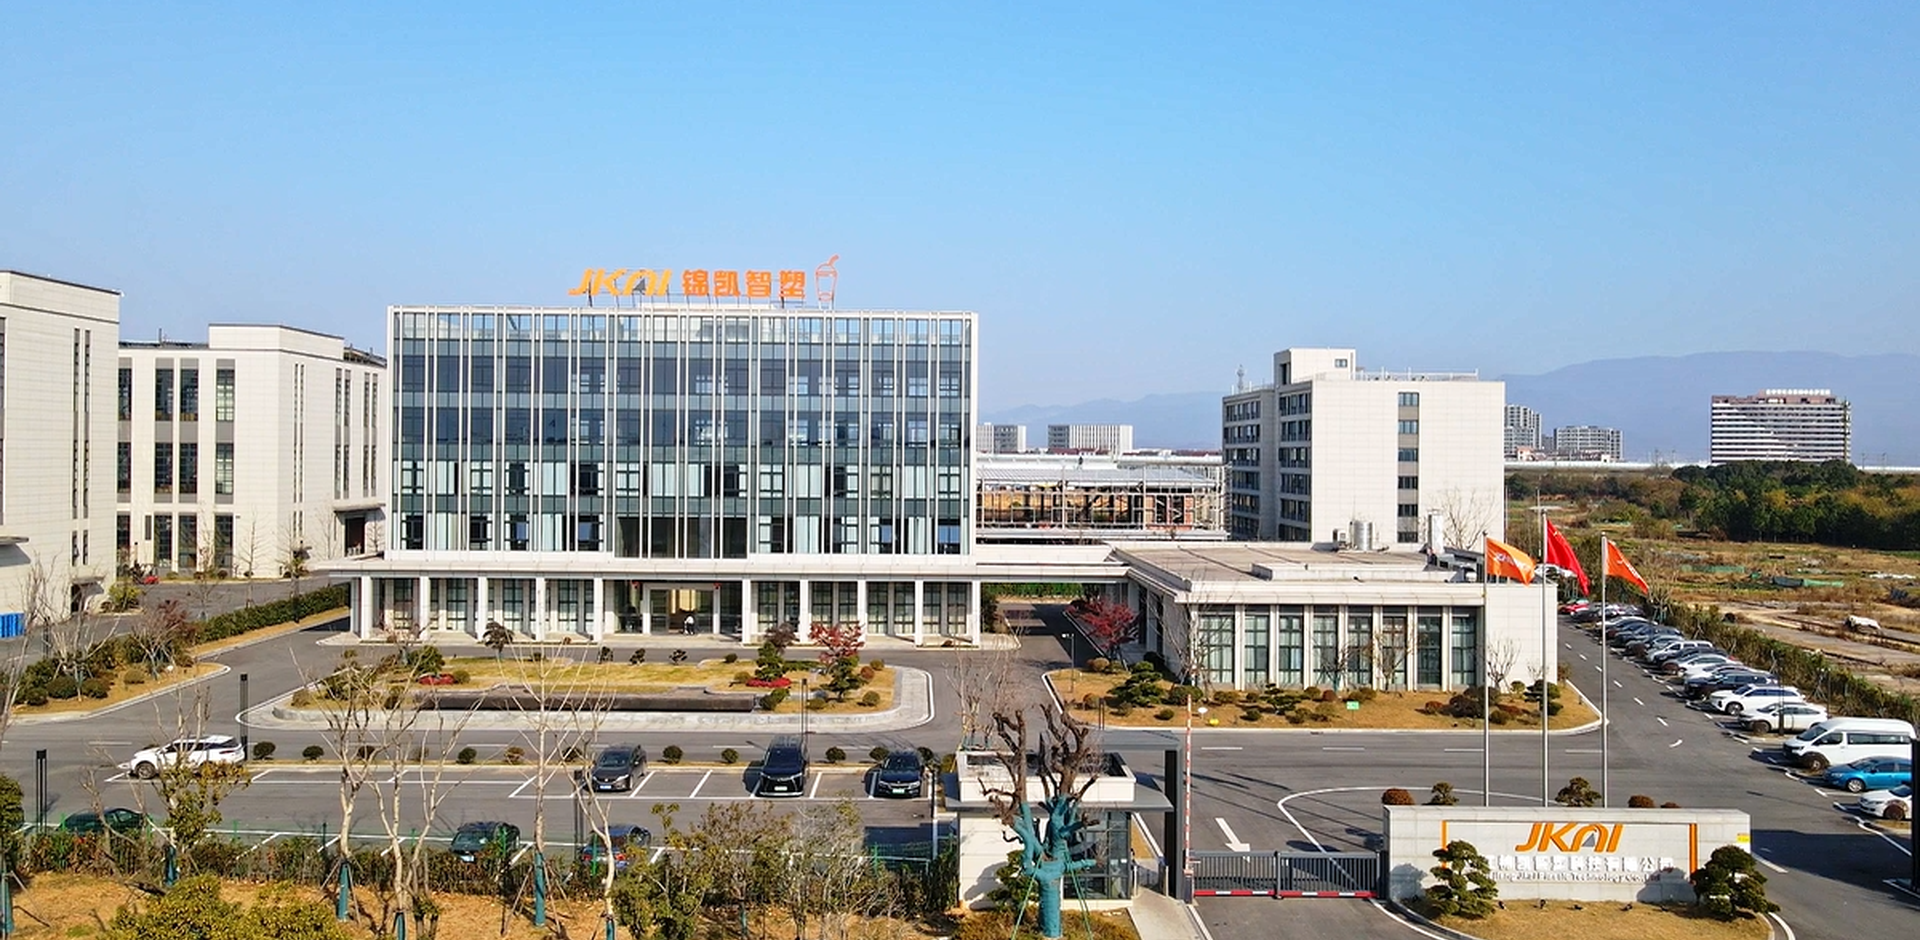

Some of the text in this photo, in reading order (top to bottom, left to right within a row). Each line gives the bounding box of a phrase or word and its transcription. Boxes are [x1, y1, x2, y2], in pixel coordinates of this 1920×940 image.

[568, 268, 806, 297] JKAI 锦凯智塑
[1515, 822, 1623, 852] JKAI
